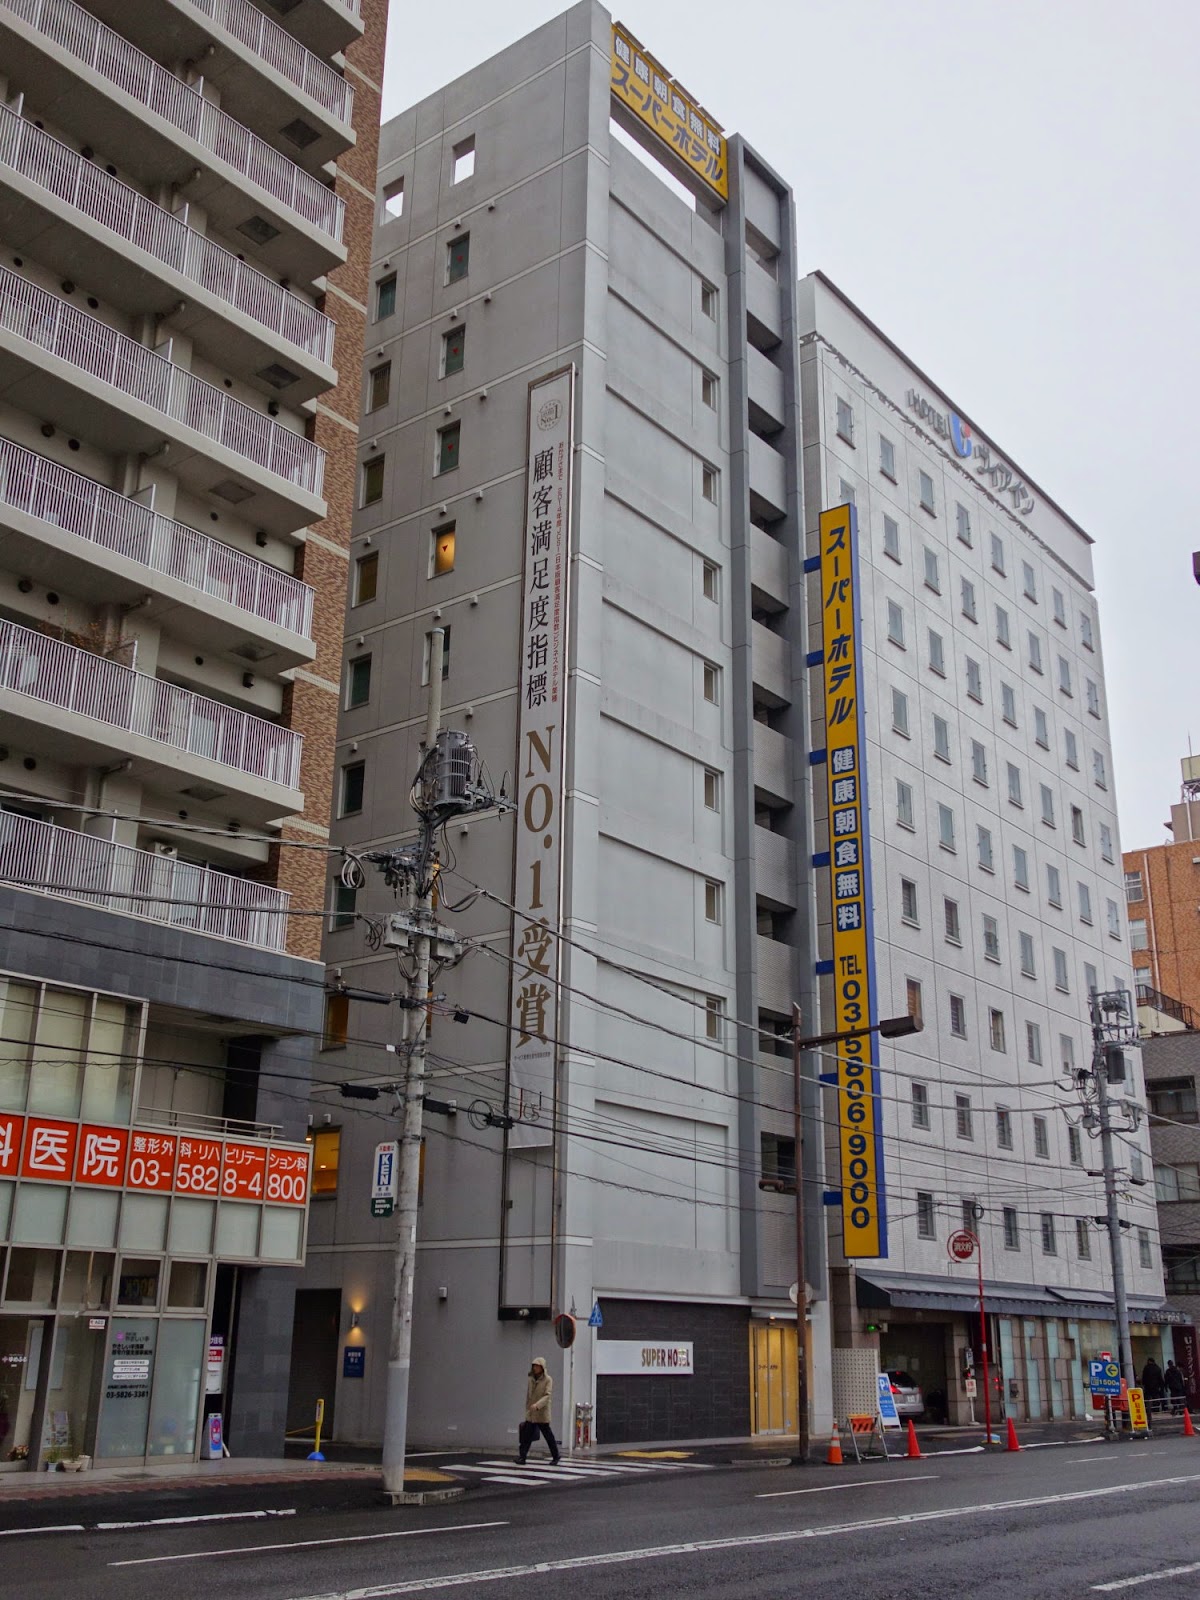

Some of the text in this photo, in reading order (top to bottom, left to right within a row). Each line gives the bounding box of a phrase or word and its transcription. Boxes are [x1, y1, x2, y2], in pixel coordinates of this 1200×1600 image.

[615, 35, 721, 157] 健康朝食無料
[612, 62, 723, 183] スーパーホテル
[906, 388, 950, 440] HOTEL
[557, 440, 565, 481] おかげさまで
[526, 446, 555, 710] 顧客満足度指標
[825, 525, 855, 729] スーパーホテル
[832, 747, 861, 930] 健康朝食無料
[839, 954, 862, 976] TEL
[133, 1136, 307, 1172] 整形外科・リハビリテーション科
[379, 1154, 390, 1186] KEN
[130, 1157, 306, 1201] 03-5828-4800
[641, 1347, 666, 1367] SUPER
[1091, 1363, 1103, 1377] P
[106, 1391, 149, 1400] 03-5826-3381
[1132, 1394, 1141, 1402] P
